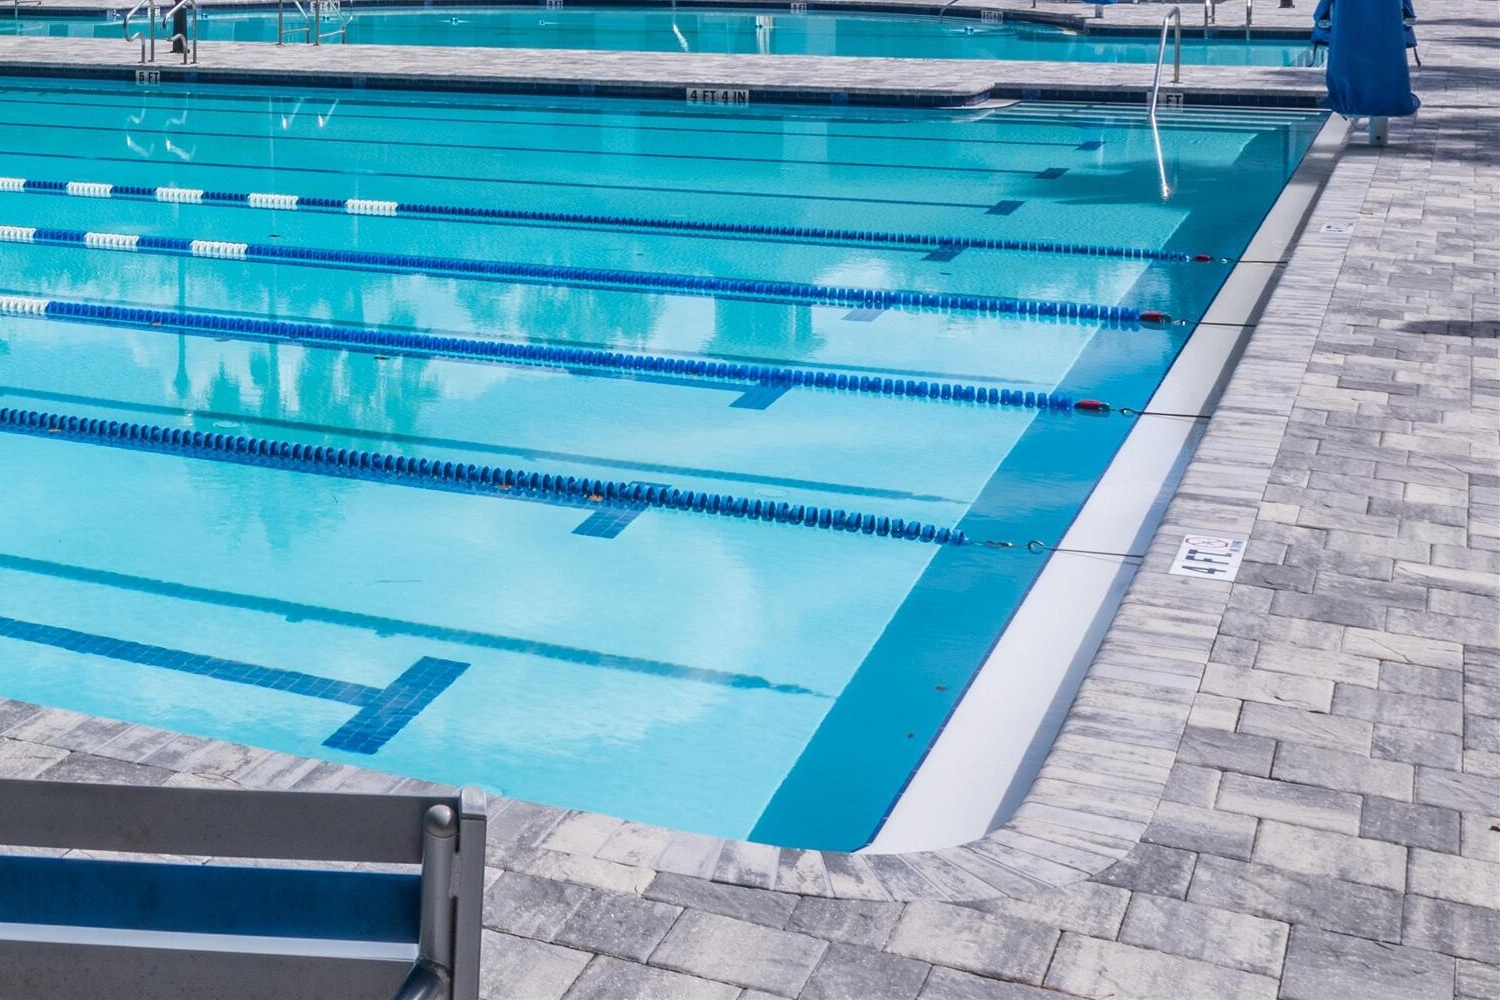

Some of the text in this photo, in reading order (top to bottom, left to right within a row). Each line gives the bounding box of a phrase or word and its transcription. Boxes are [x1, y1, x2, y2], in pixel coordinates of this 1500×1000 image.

[148, 71, 159, 81] FT
[690, 89, 746, 103] 4 FT 4 IN
[1166, 94, 1182, 105] FT
[1181, 565, 1228, 575] 4
